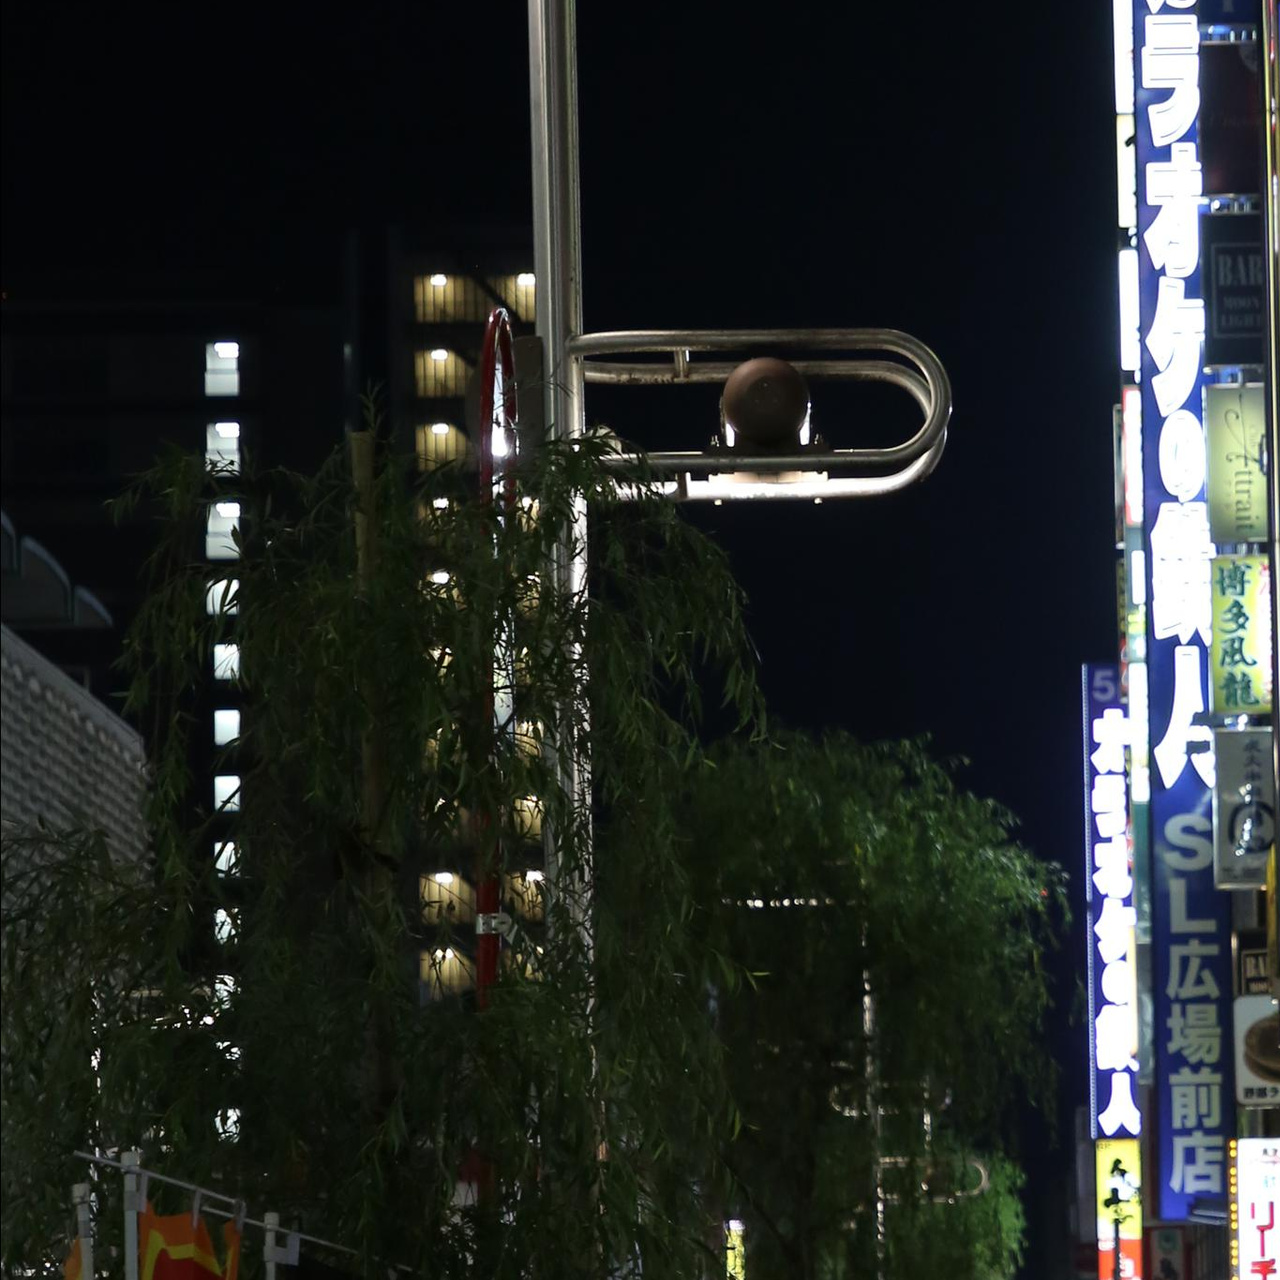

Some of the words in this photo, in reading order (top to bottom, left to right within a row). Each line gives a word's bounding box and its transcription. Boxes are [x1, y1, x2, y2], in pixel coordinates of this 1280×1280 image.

[1216, 560, 1260, 707] 博多風龍
[1163, 812, 1223, 1196] SL広場前店
